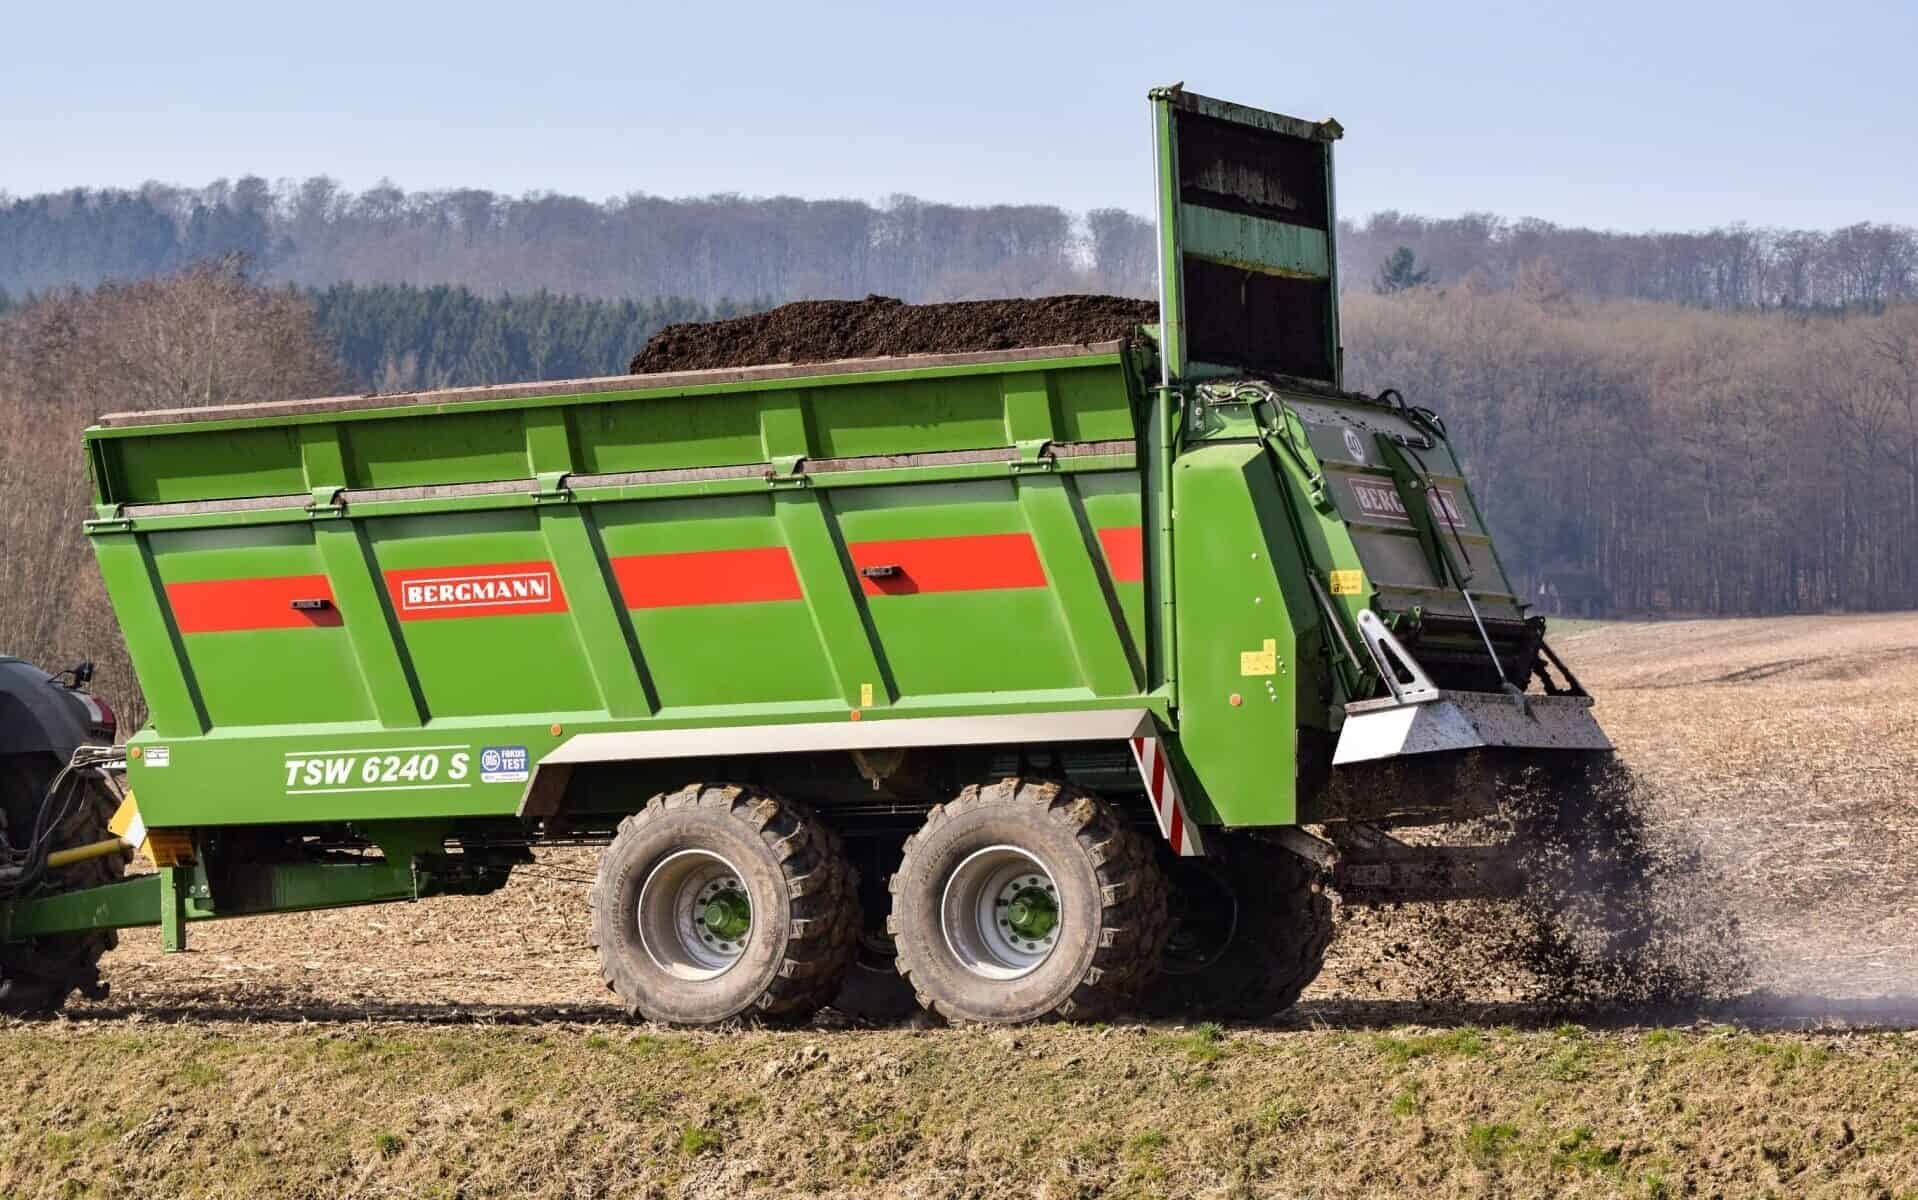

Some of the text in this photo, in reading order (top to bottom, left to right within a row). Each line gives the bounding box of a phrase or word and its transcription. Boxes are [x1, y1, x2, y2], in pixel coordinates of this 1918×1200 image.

[407, 578, 545, 604] BERGMANN
[285, 752, 471, 786] TSW 6240 S
[502, 758, 526, 770] TEST
